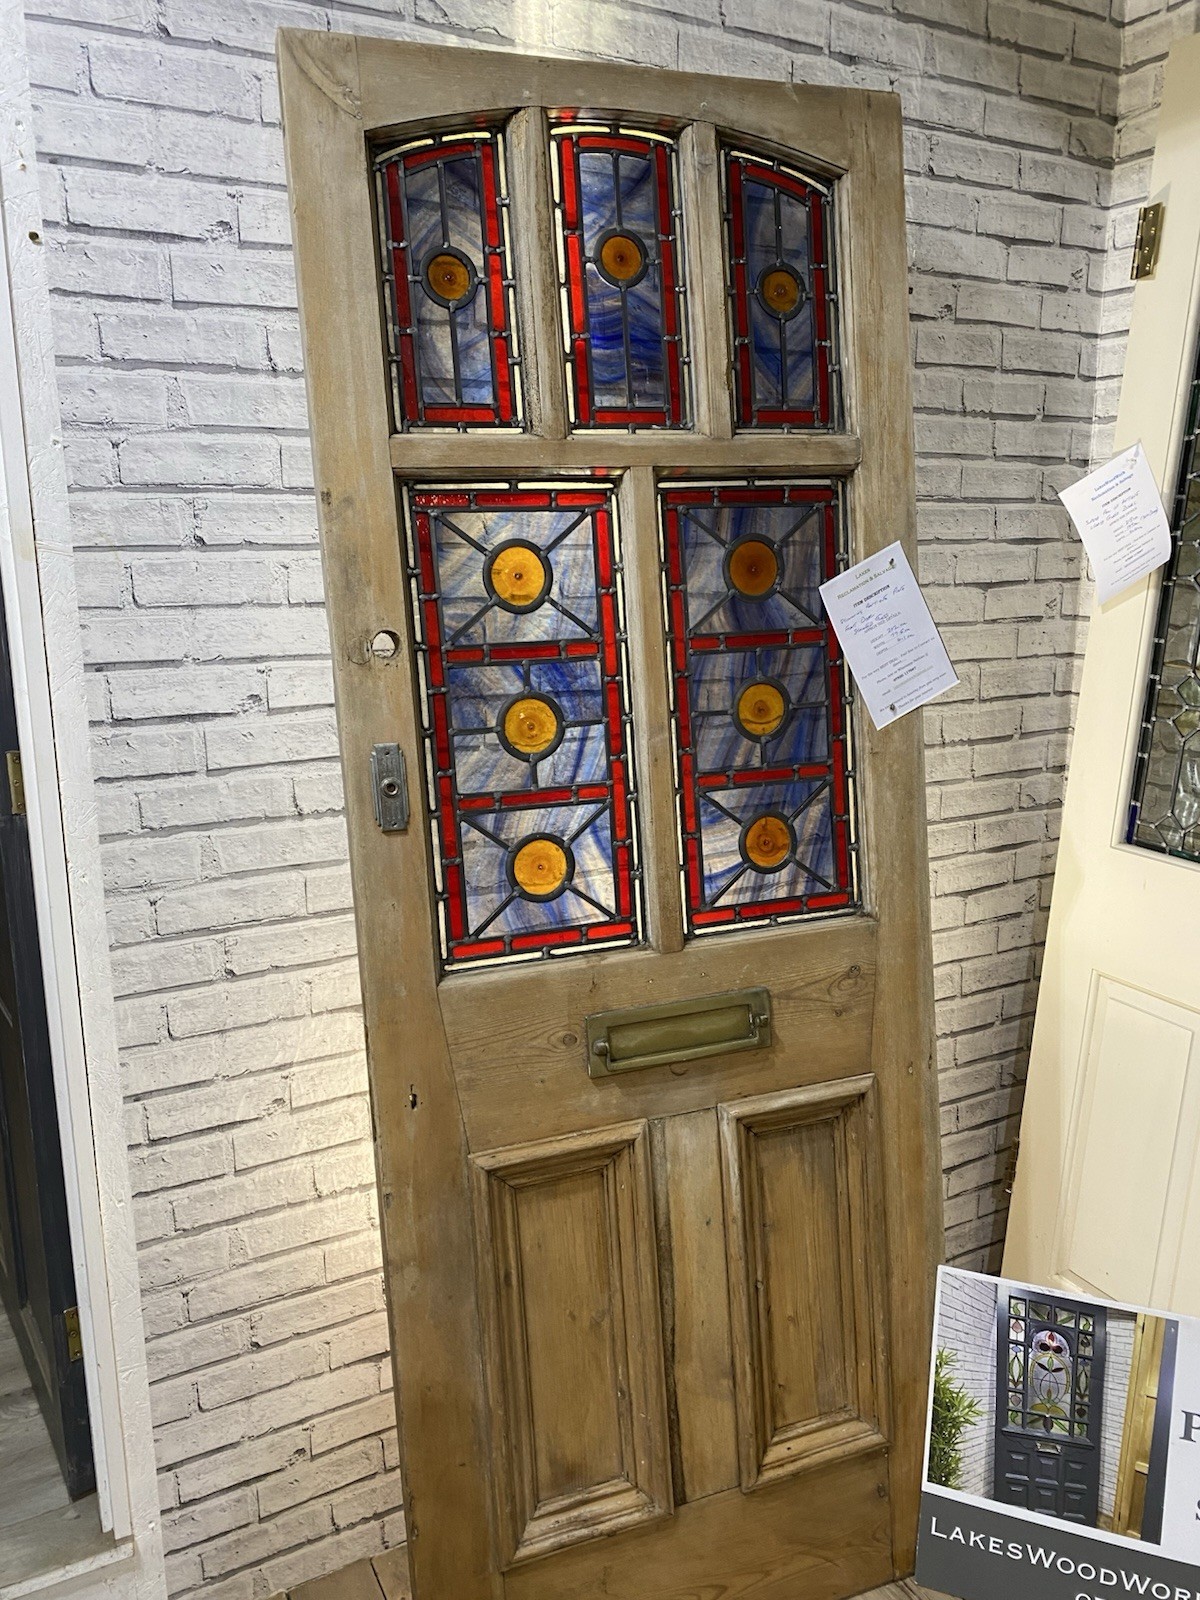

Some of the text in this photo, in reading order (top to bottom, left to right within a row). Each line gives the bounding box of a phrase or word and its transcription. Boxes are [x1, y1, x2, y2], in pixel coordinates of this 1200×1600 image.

[855, 568, 870, 580] LAKES
[837, 579, 869, 600] RECLAMATION
[864, 584, 890, 602] DESCRIPTION
[930, 1516, 1200, 1600] LAKESWOODWOR
